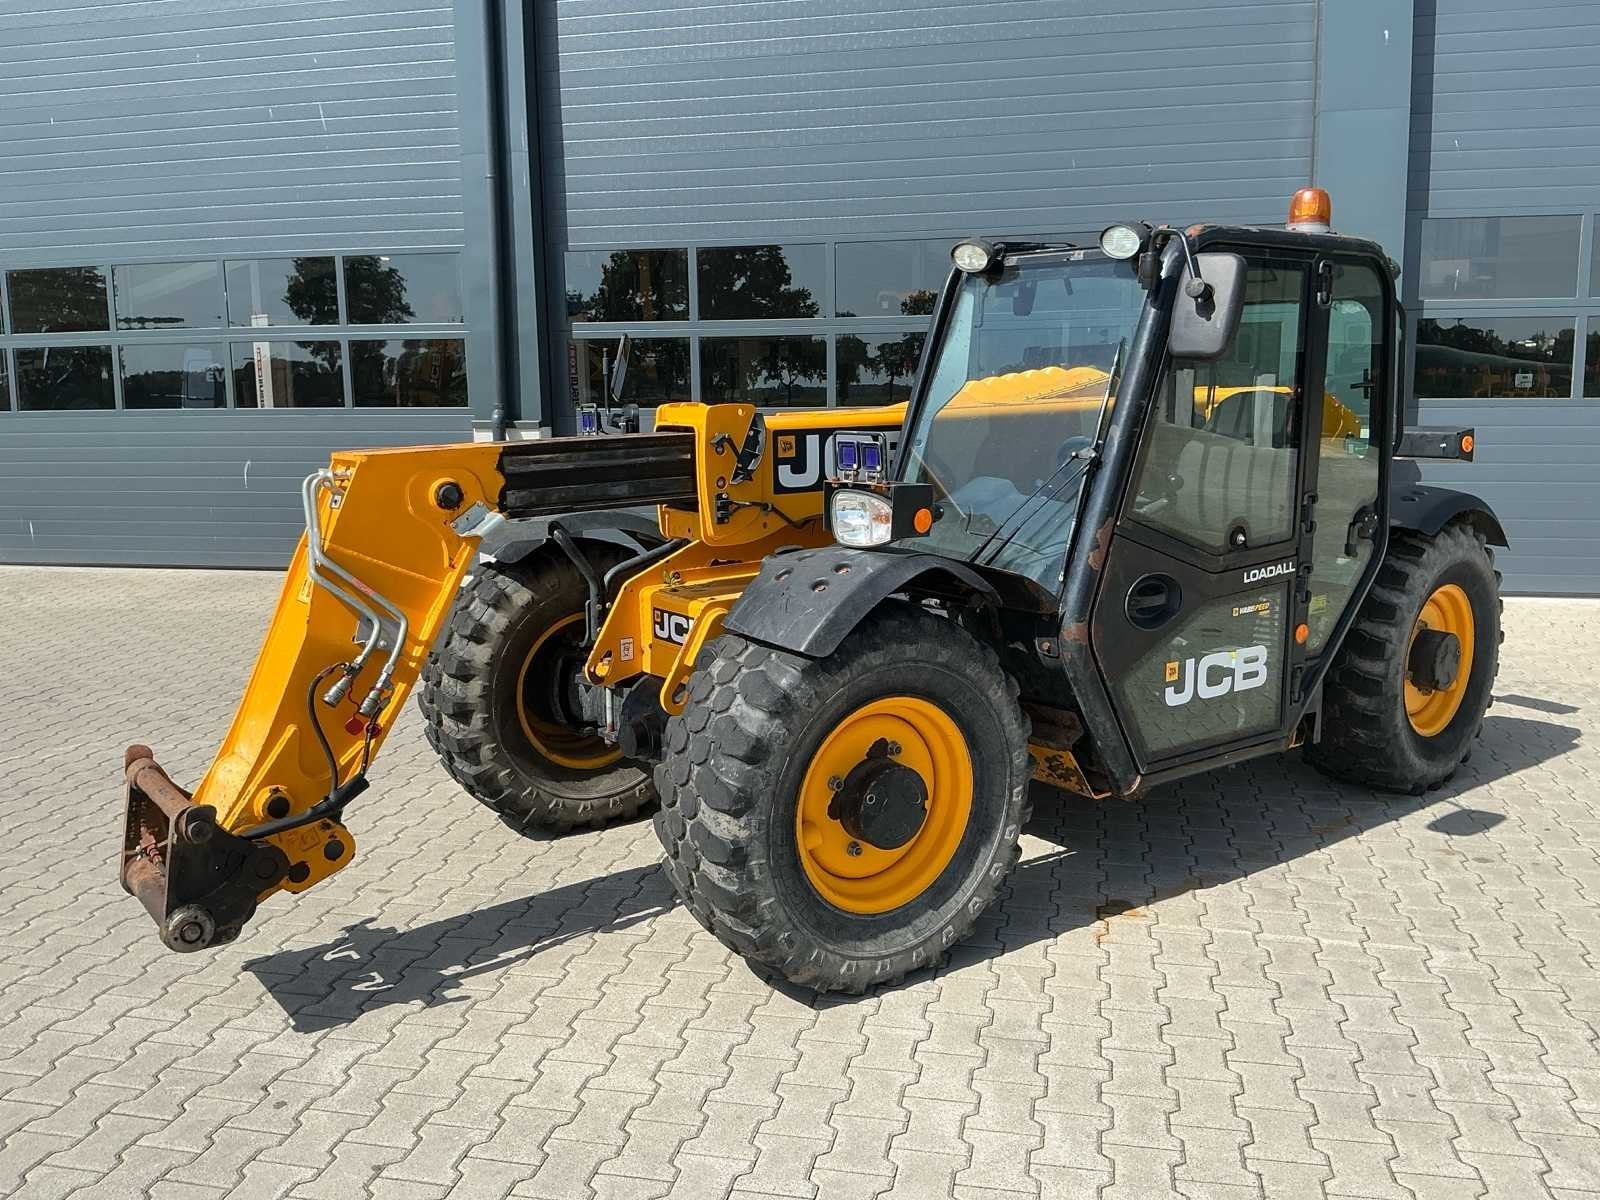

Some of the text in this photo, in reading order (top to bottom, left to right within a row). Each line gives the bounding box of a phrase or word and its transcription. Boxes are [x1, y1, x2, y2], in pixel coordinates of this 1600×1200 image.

[777, 432, 899, 488] JC
[1243, 561, 1296, 583] LOADALL
[655, 612, 695, 643] JC
[1165, 645, 1268, 706] JCB
